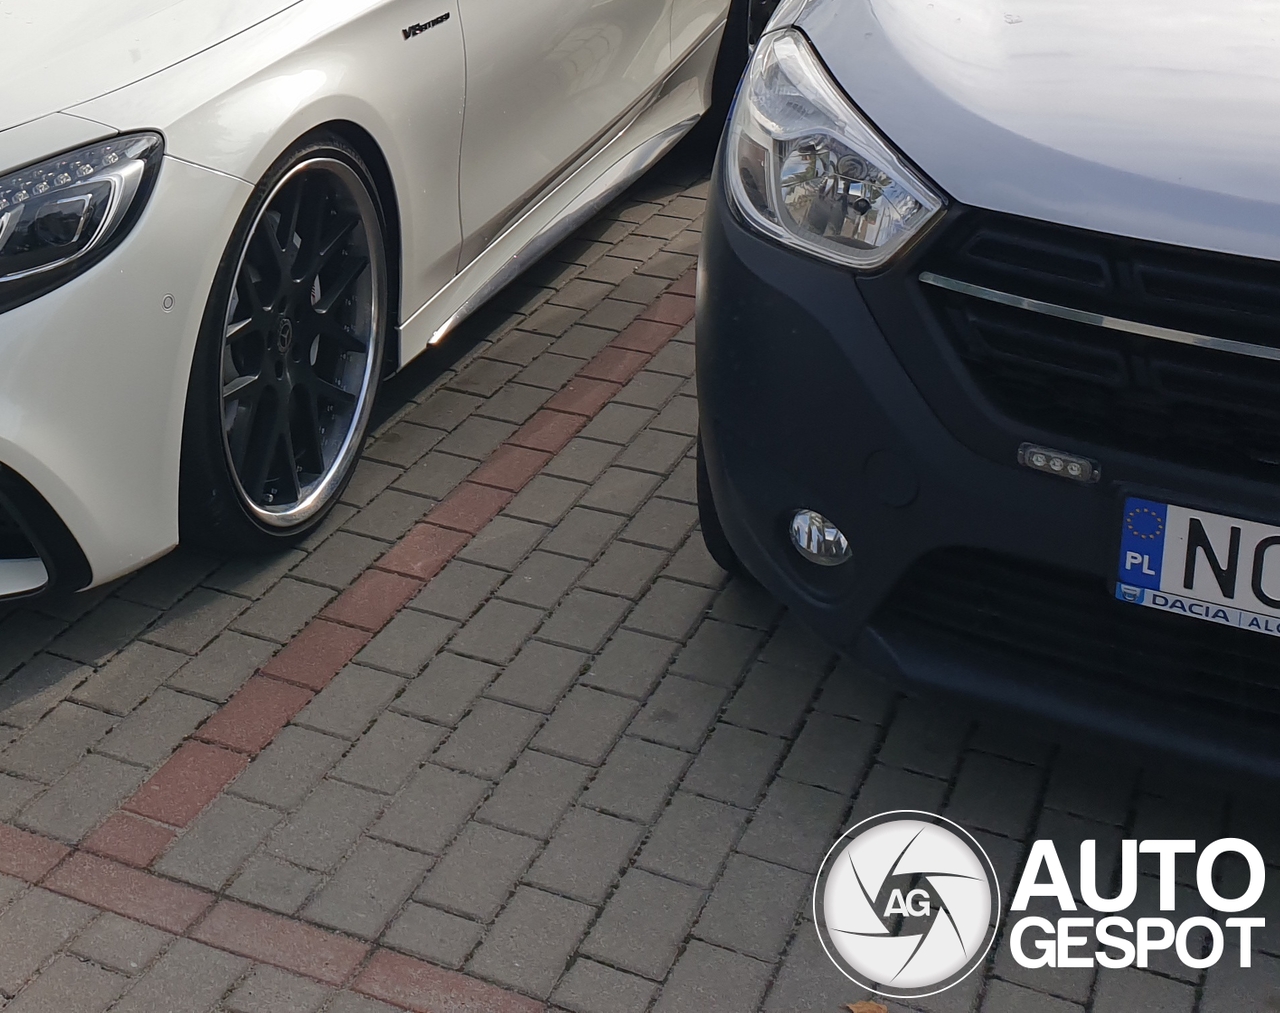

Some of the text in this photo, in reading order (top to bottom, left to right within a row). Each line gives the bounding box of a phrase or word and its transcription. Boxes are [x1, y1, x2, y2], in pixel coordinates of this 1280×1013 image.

[1125, 551, 1155, 576] PL
[1152, 594, 1280, 634] DACIA AL
